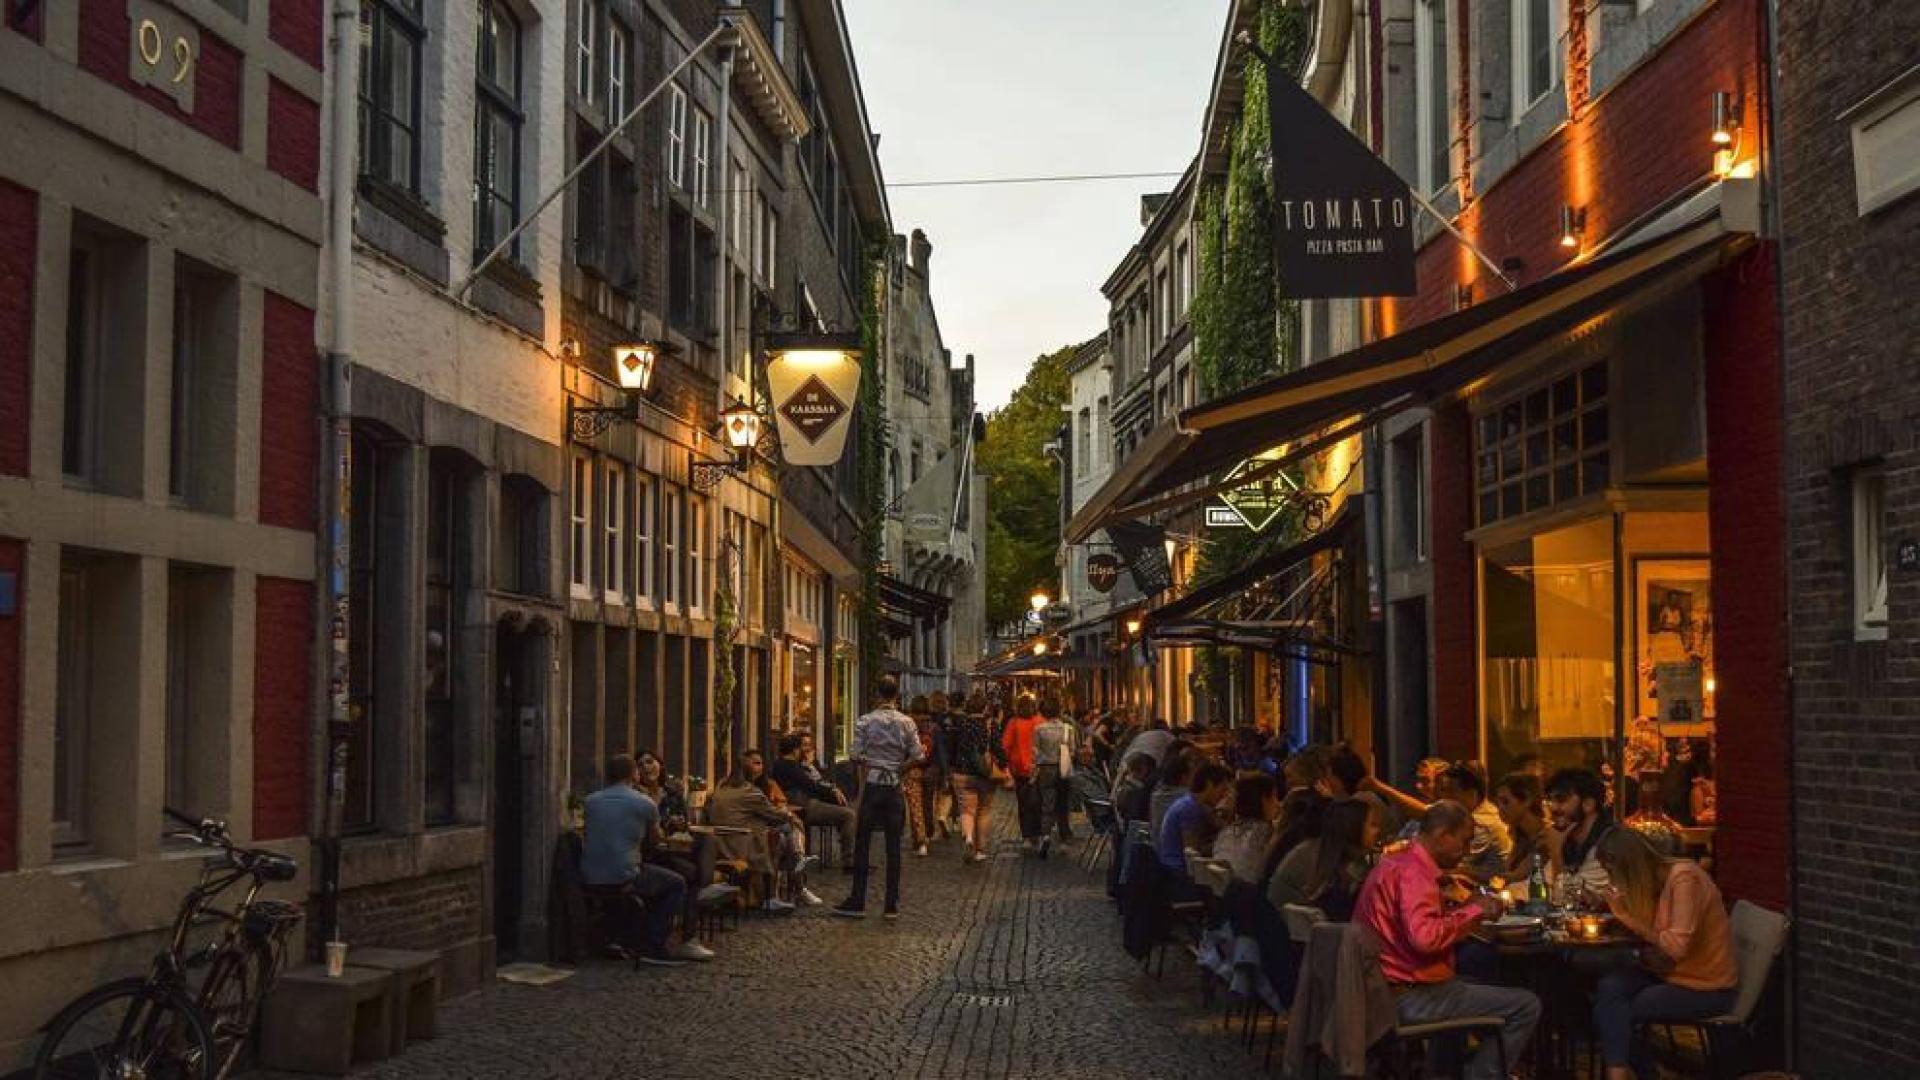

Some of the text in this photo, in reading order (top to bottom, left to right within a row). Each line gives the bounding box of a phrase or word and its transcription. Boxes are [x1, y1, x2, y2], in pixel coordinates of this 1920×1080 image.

[1281, 199, 1404, 230] TOMATO
[1306, 238, 1384, 255] PIZZA PASTA BAR
